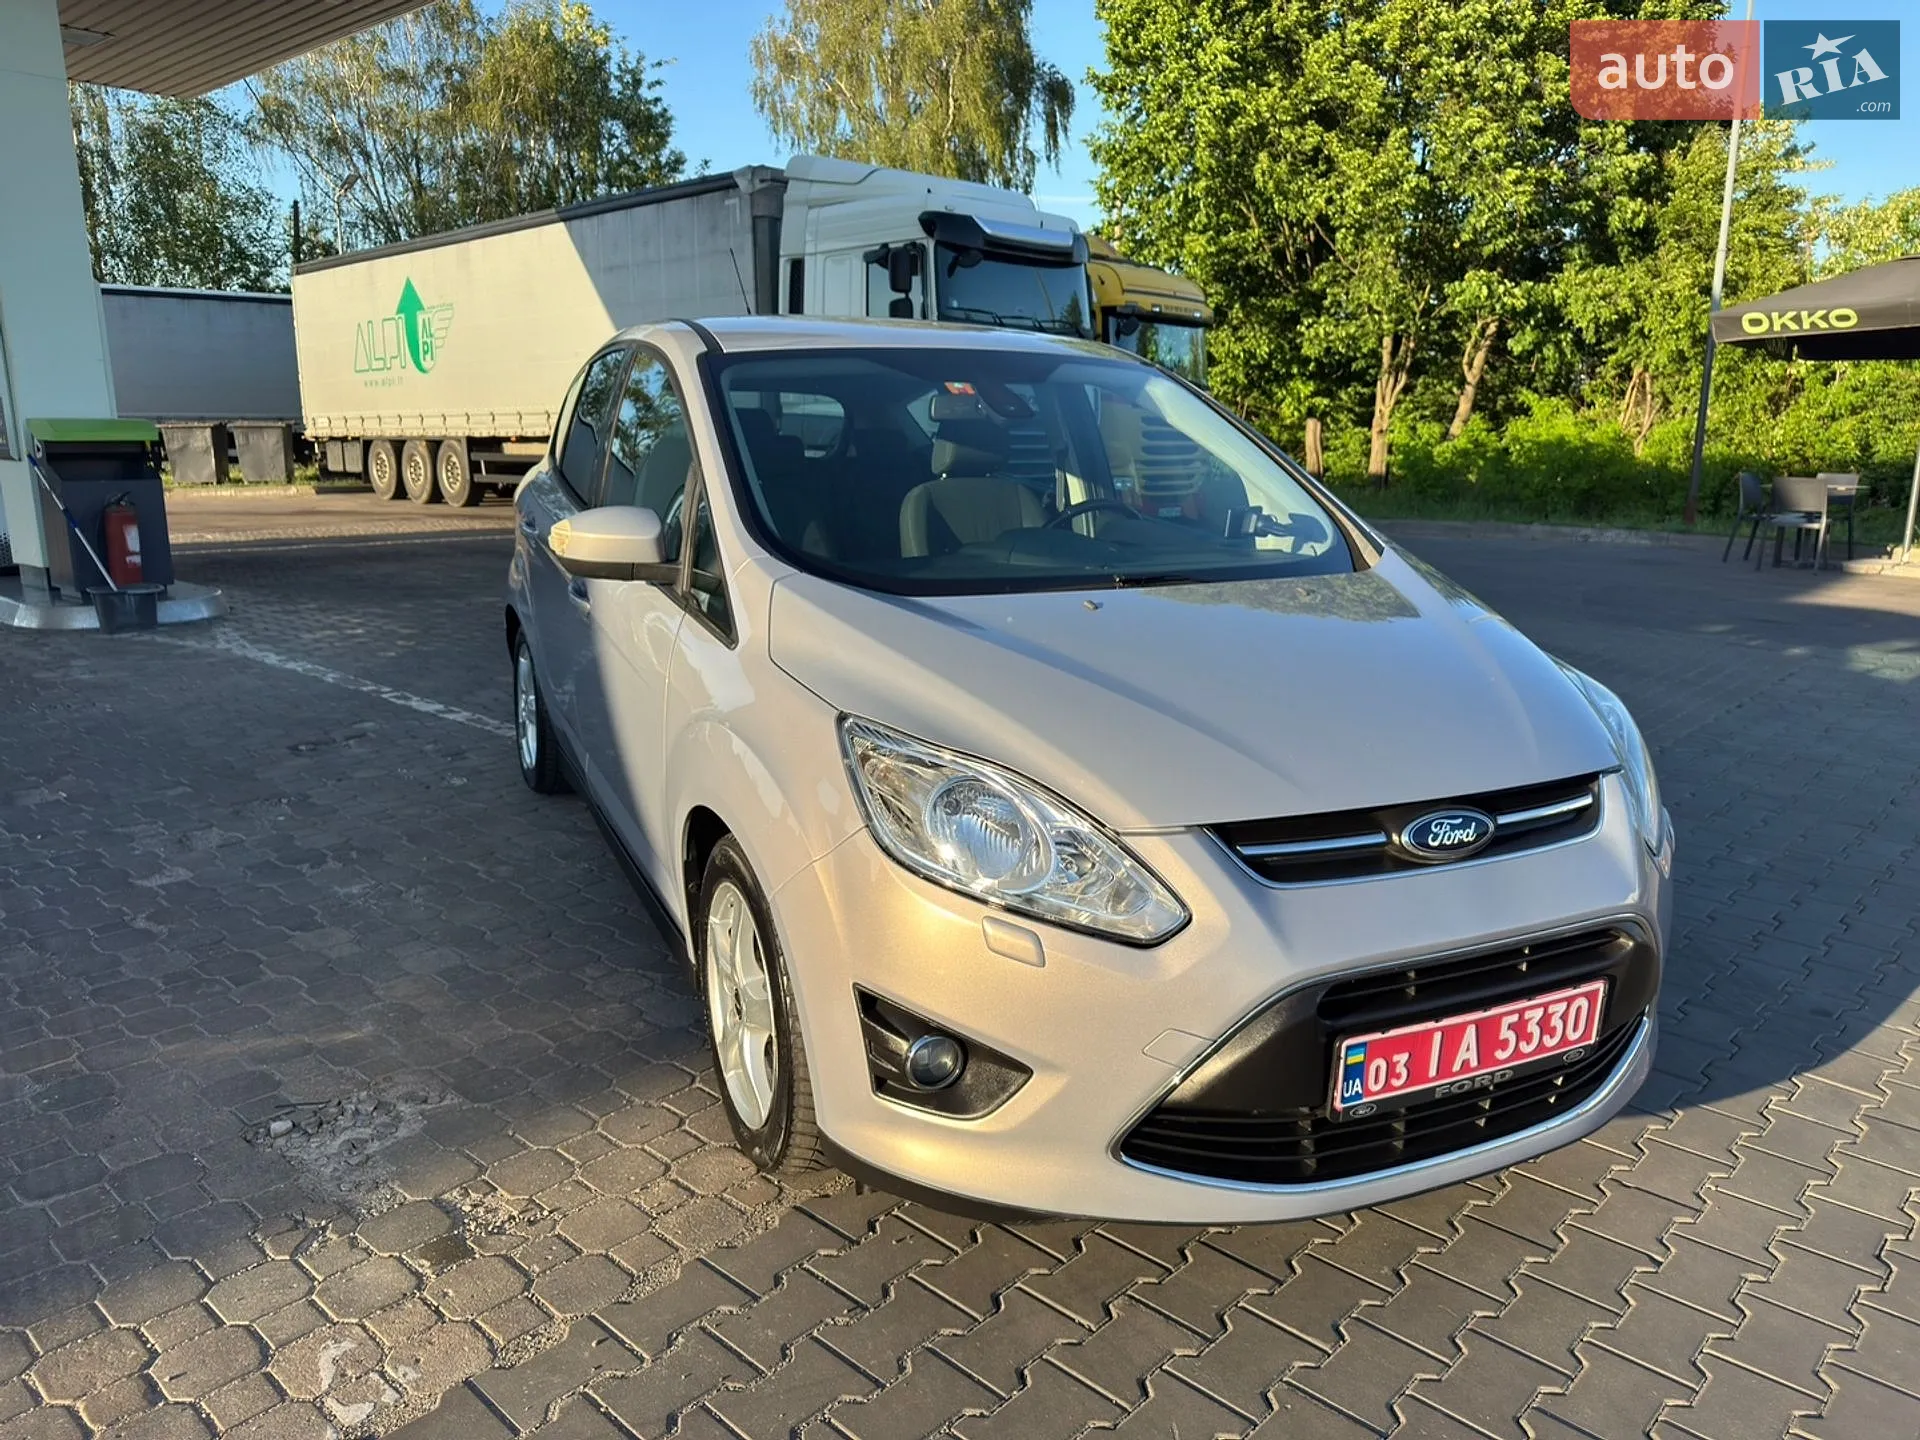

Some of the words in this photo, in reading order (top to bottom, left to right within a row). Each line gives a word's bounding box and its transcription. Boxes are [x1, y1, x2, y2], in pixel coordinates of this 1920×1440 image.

[1741, 308, 1857, 334] OKKO
[354, 316, 406, 373] ALPI
[1428, 818, 1477, 847] Ford
[1367, 1051, 1410, 1092] 03
[1494, 996, 1589, 1061] 5330
[1343, 1080, 1363, 1097] UA
[1434, 1069, 1515, 1098] FORD
